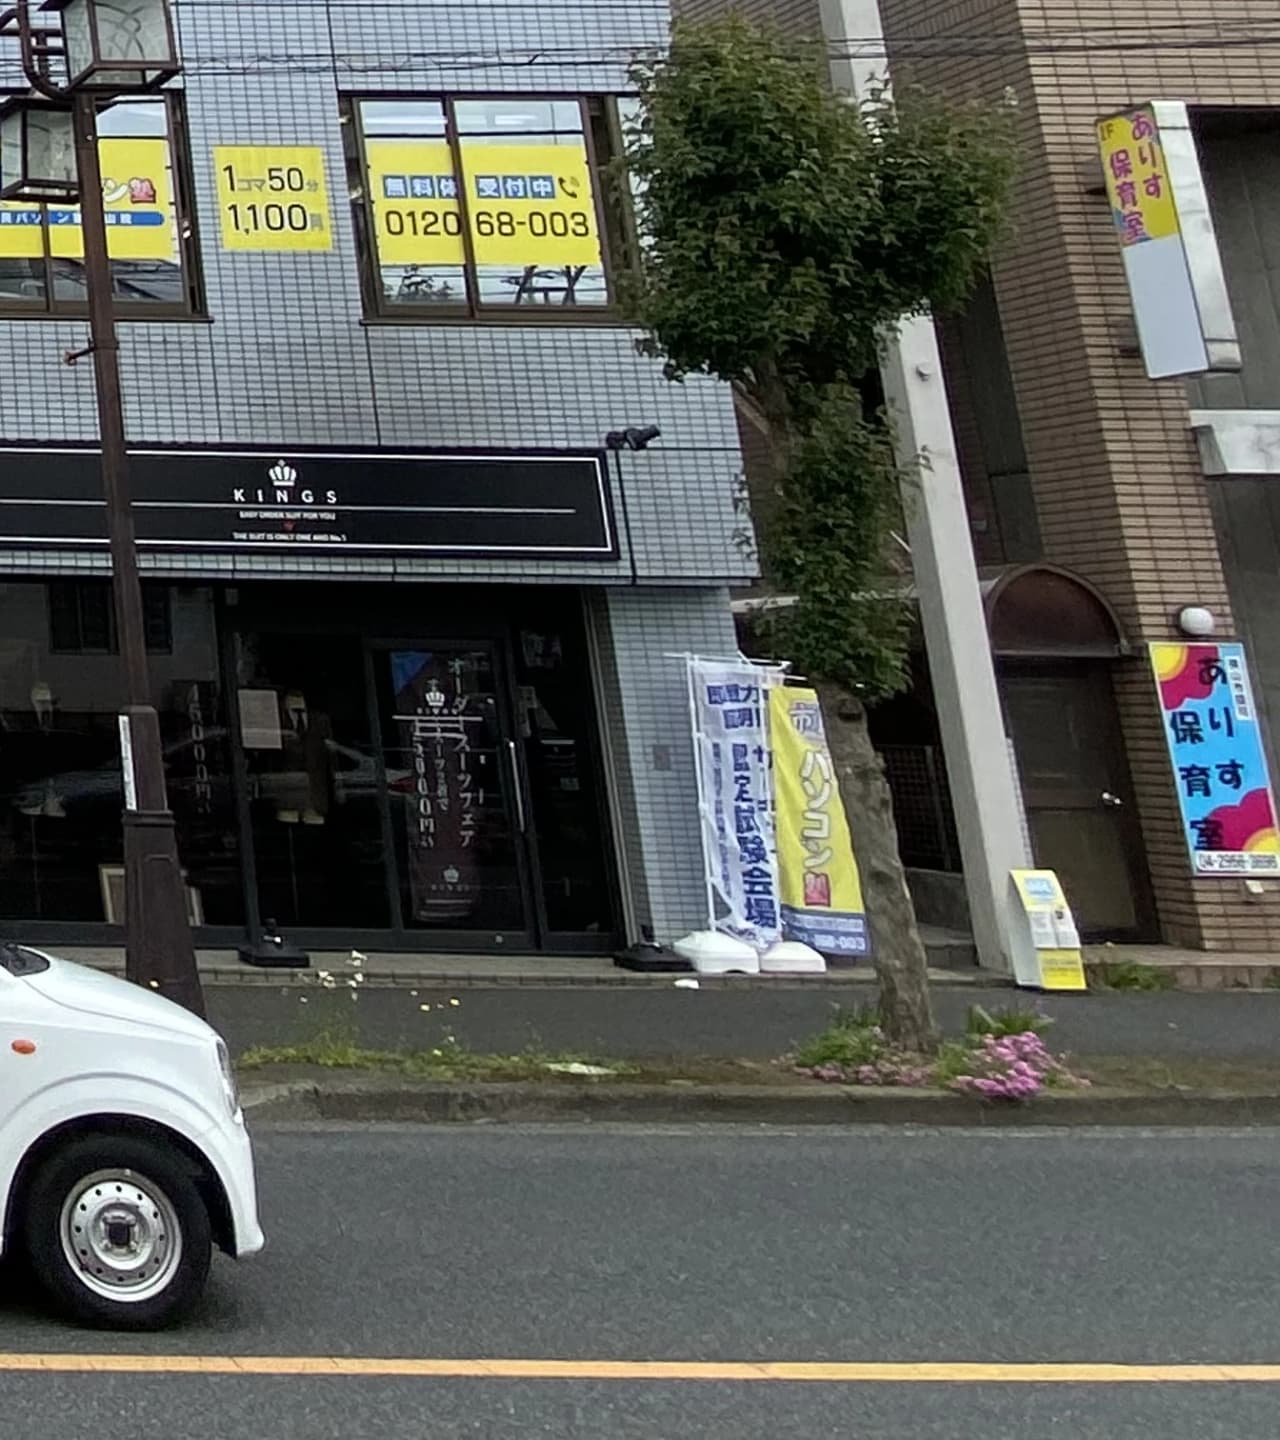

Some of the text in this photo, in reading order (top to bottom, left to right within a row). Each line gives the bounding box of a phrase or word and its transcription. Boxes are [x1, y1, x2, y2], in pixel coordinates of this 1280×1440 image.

[1109, 148, 1144, 242] 保育室
[1131, 112, 1162, 199] ありす
[233, 488, 337, 504] KINGS
[1198, 656, 1244, 790] ありす
[1170, 710, 1223, 851] 保育室
